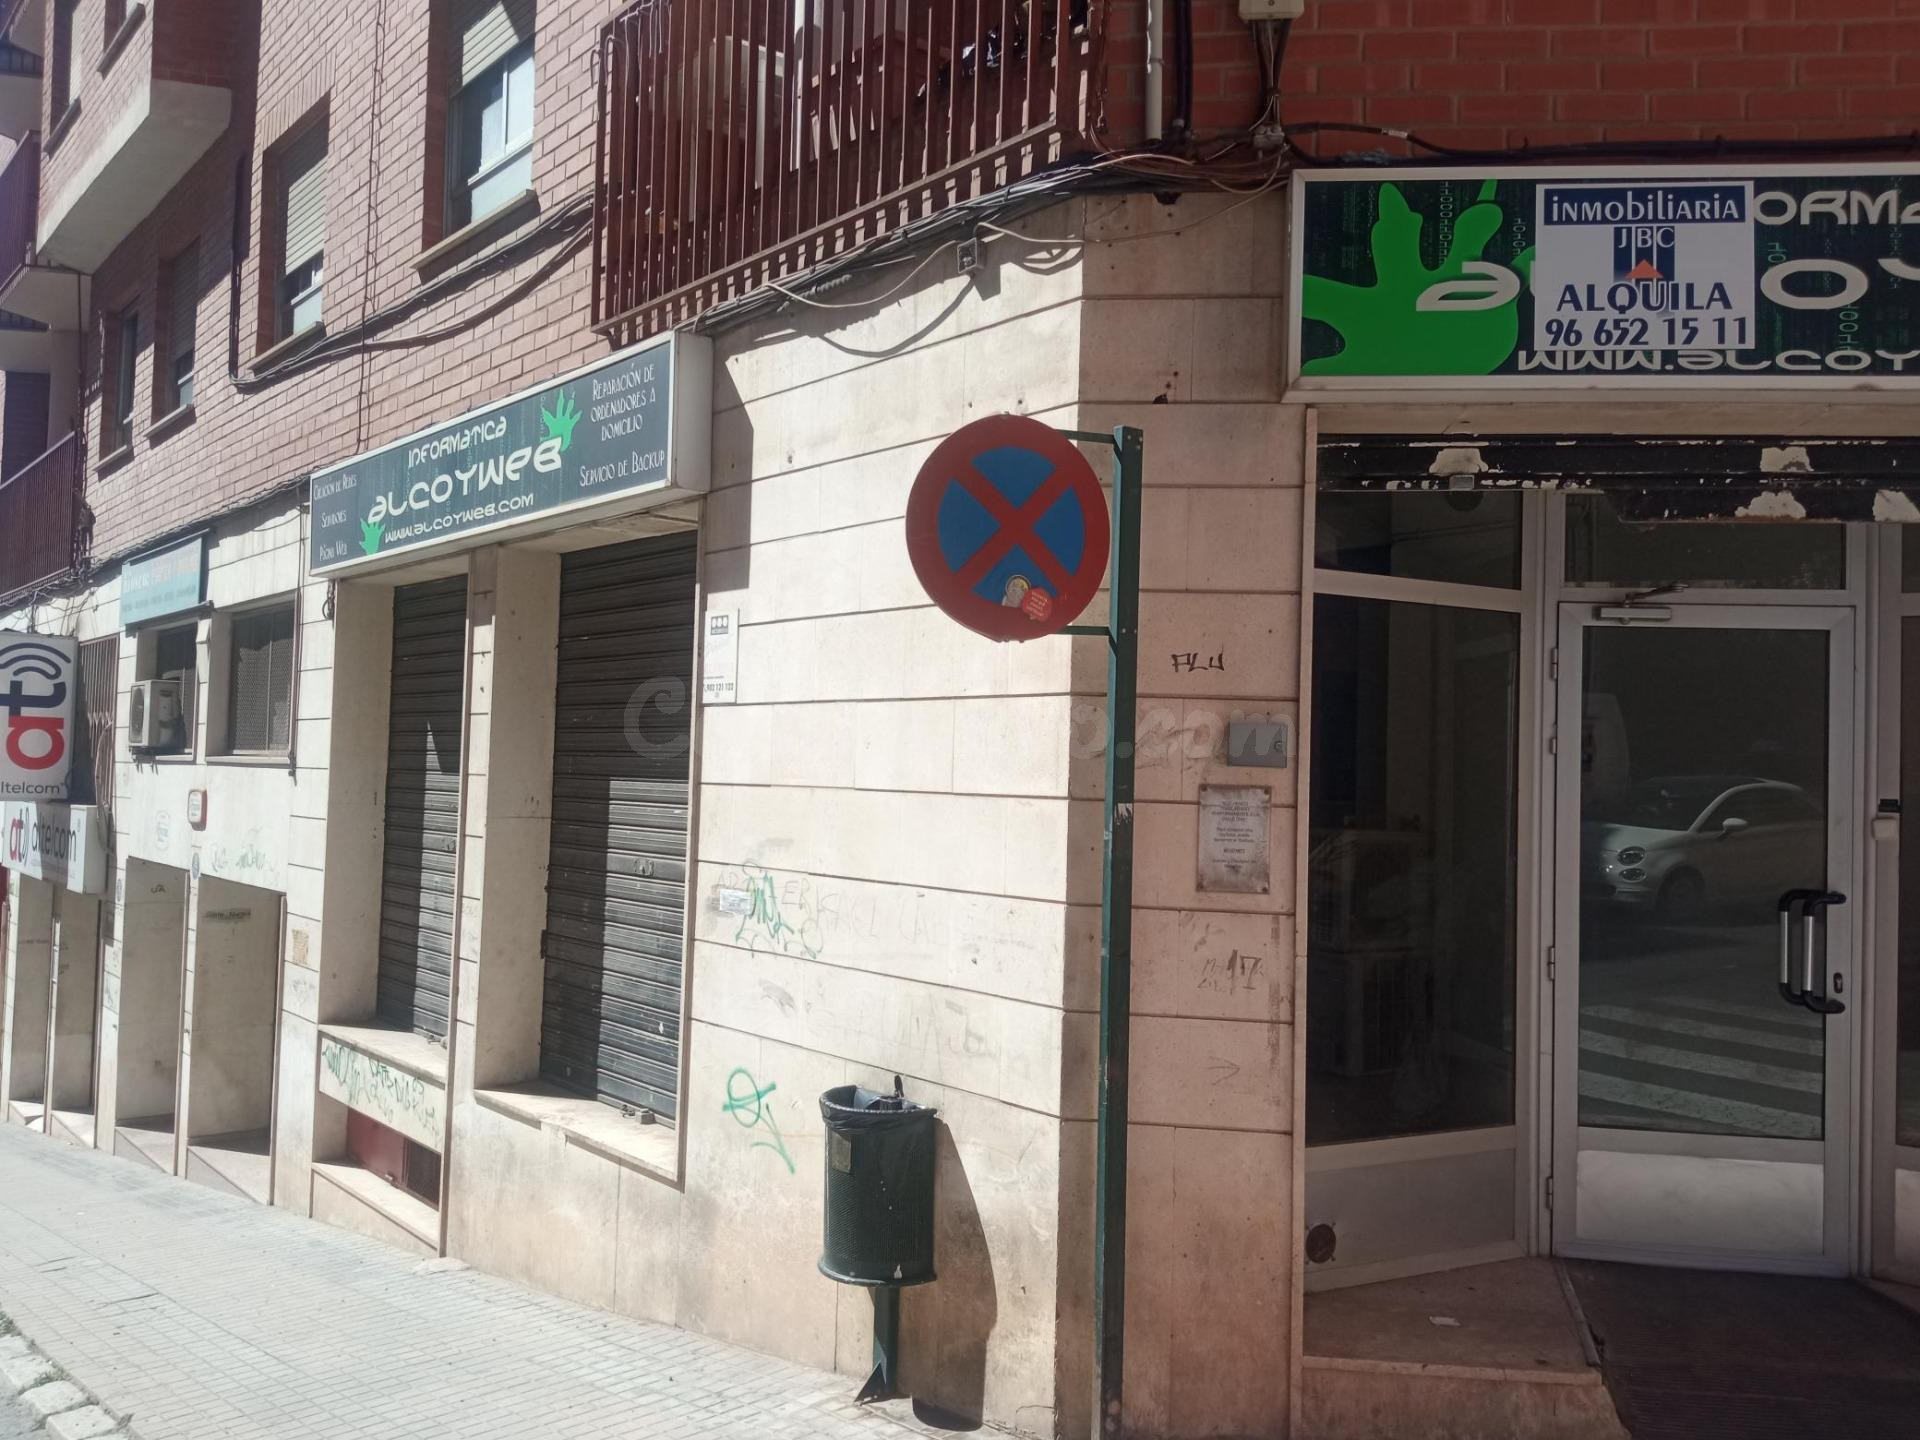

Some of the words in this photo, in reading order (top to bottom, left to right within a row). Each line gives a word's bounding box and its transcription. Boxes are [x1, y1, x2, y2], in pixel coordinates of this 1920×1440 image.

[1617, 227, 1675, 248] JBC
[1556, 282, 1733, 315] ALQUILA
[1545, 318, 1583, 347] 96
[1593, 317, 1649, 346] 652
[1662, 317, 1699, 345] 15
[1712, 316, 1747, 345] 11
[592, 363, 641, 401] REPARACIÓN
[643, 364, 655, 383] DE
[590, 389, 647, 423] ORDENADORES
[650, 387, 656, 403] A
[601, 414, 643, 441] DOMICILIO
[579, 464, 616, 487] SERVICIO
[617, 459, 629, 477] DE
[632, 450, 665, 474] BACKUP
